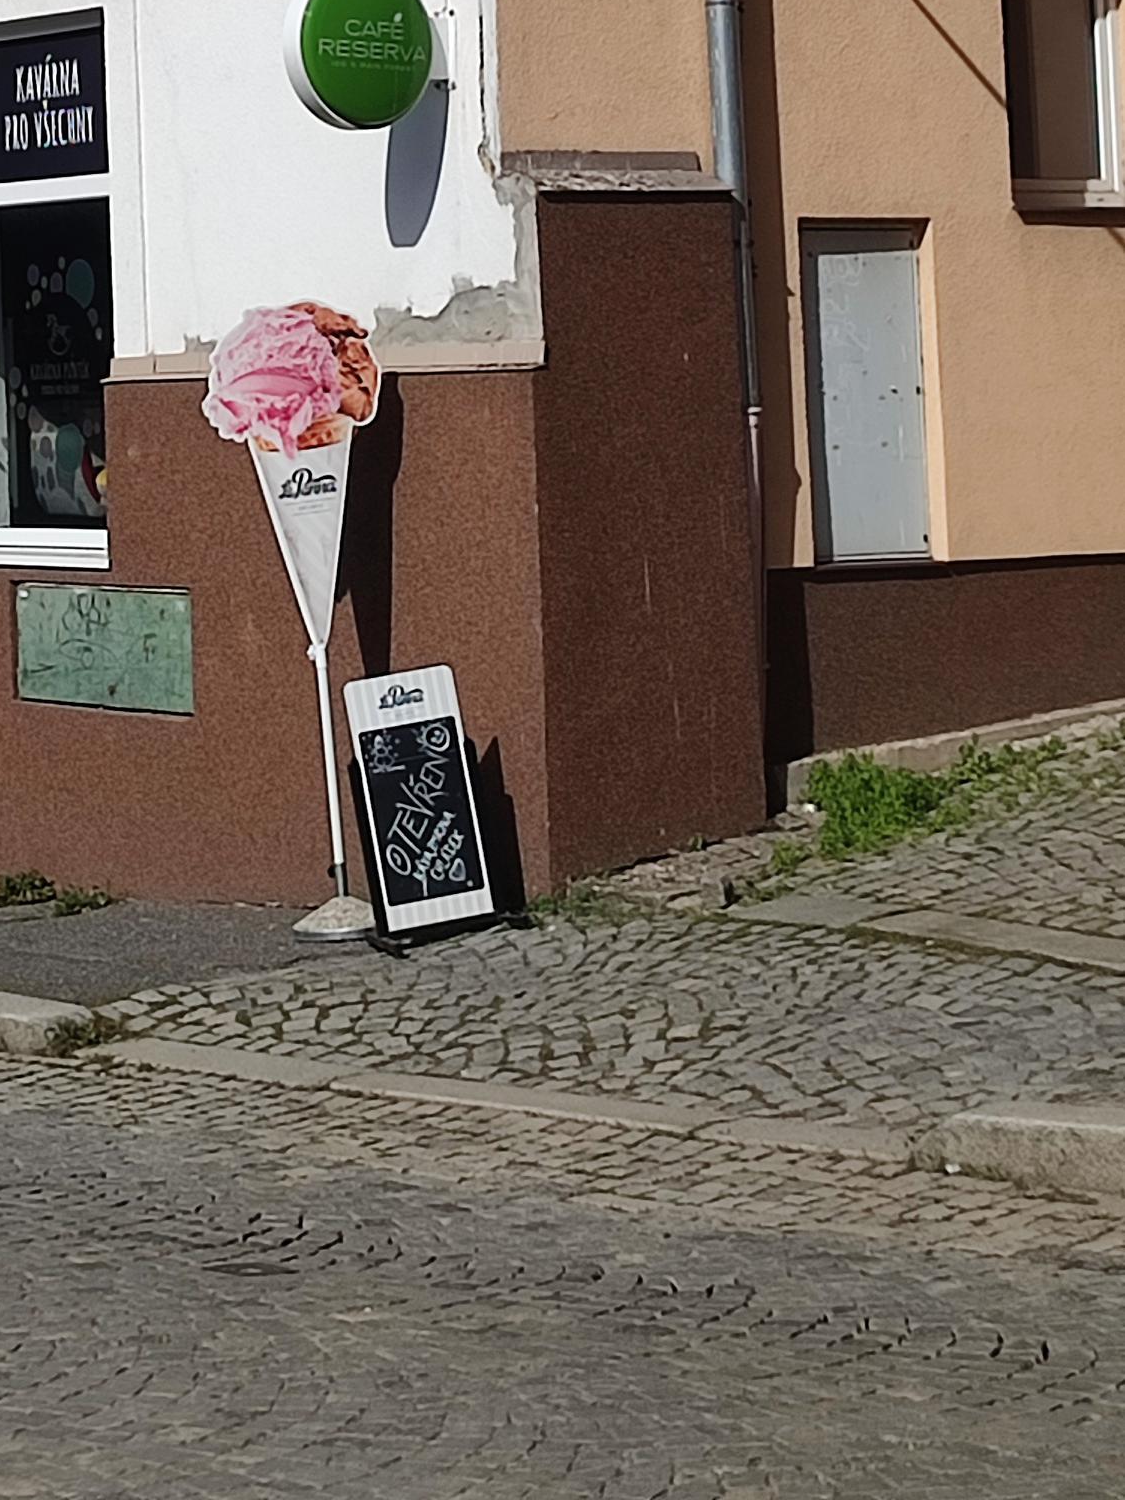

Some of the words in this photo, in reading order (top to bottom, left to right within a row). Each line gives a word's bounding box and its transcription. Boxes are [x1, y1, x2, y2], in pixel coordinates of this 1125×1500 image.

[344, 12, 404, 41] CAFÉ
[318, 38, 428, 62] RESERVA
[15, 53, 80, 103] KAVÁRNA
[4, 113, 29, 152] PRO
[33, 99, 94, 149] VŠECHNY
